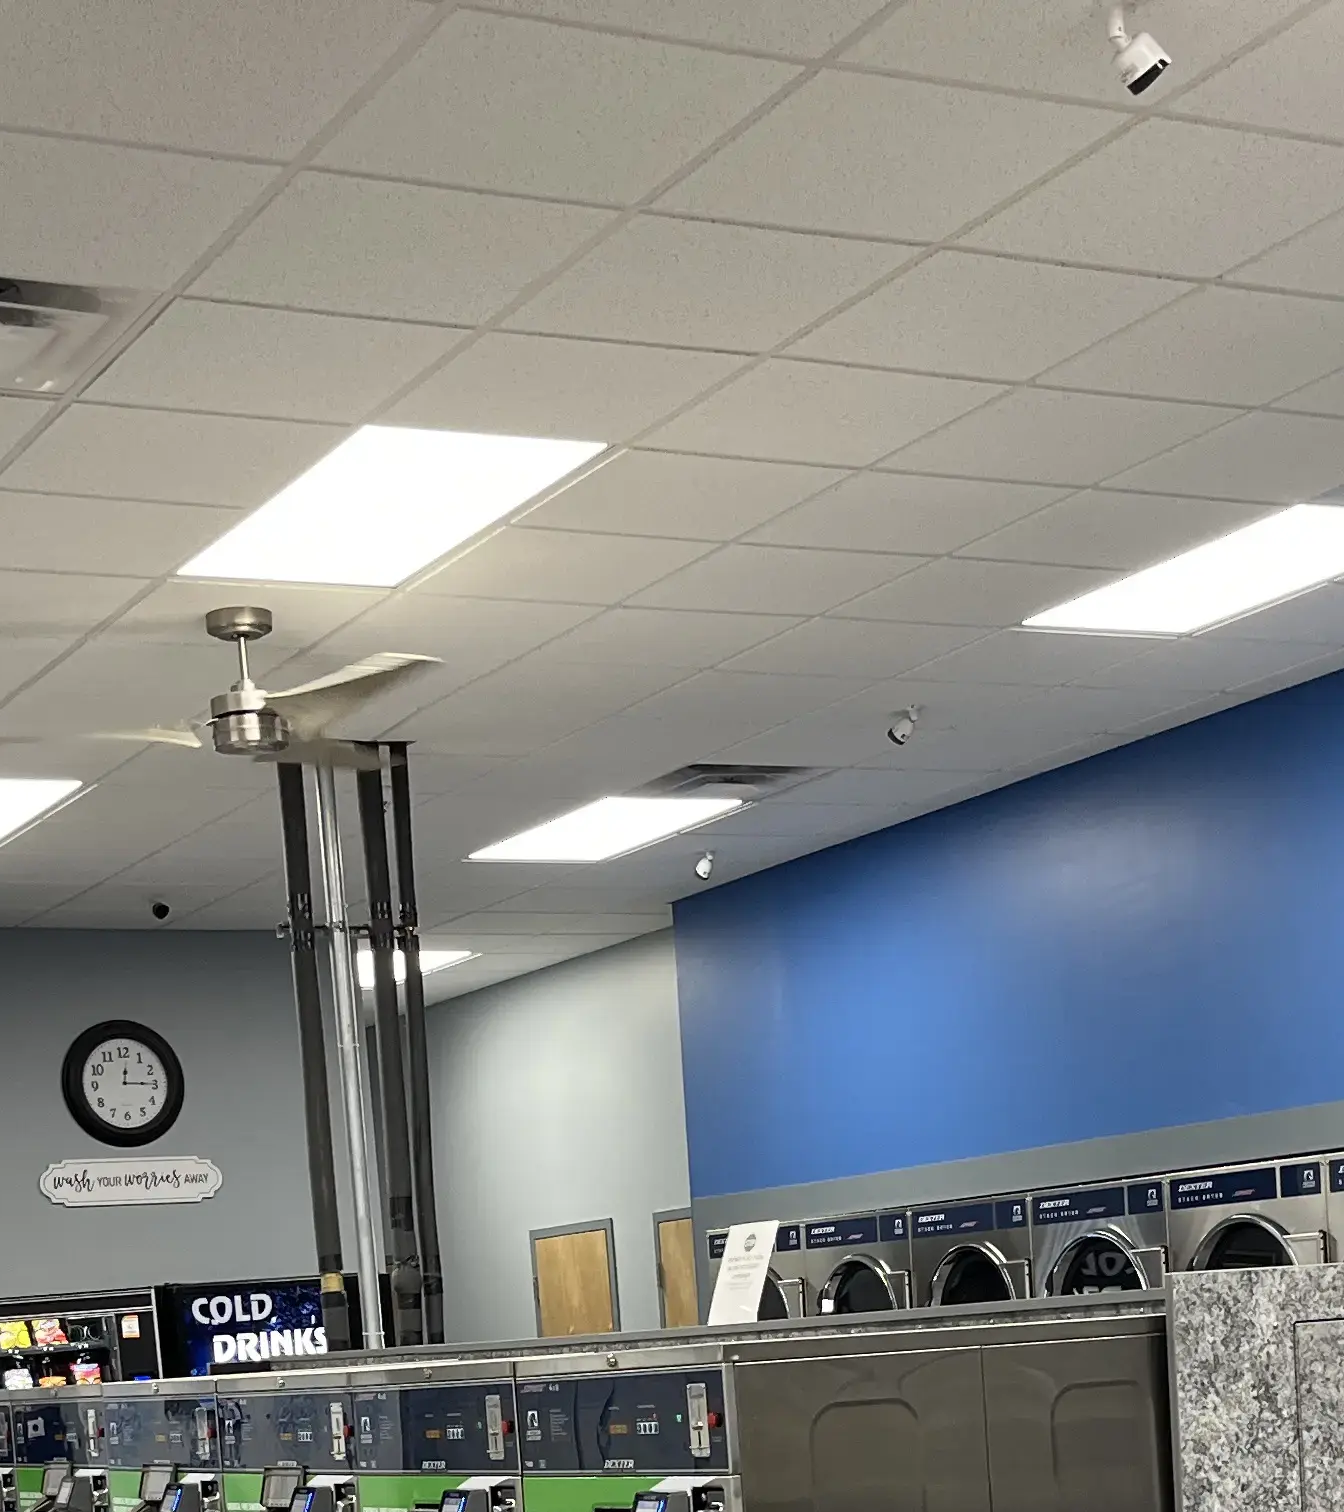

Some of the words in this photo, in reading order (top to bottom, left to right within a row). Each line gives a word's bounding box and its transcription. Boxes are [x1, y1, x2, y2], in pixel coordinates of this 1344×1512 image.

[101, 1051, 114, 1063] 11
[116, 1046, 130, 1059] 12
[136, 1052, 143, 1064] 1
[91, 1063, 104, 1076] 10
[147, 1064, 154, 1076] 2
[91, 1081, 99, 1092] 9
[151, 1080, 158, 1090] 3
[97, 1097, 105, 1108] 8
[148, 1096, 156, 1105] 4
[109, 1108, 116, 1118] 7
[124, 1111, 131, 1121] 6
[139, 1107, 146, 1117] 5
[53, 1169, 95, 1193] wash
[96, 1176, 122, 1188] YOUR
[124, 1169, 181, 1190] worries
[183, 1172, 209, 1184] AWAY
[1178, 1181, 1213, 1193] DEXTER
[191, 1293, 273, 1325] COLD
[212, 1326, 328, 1363] DRINKS
